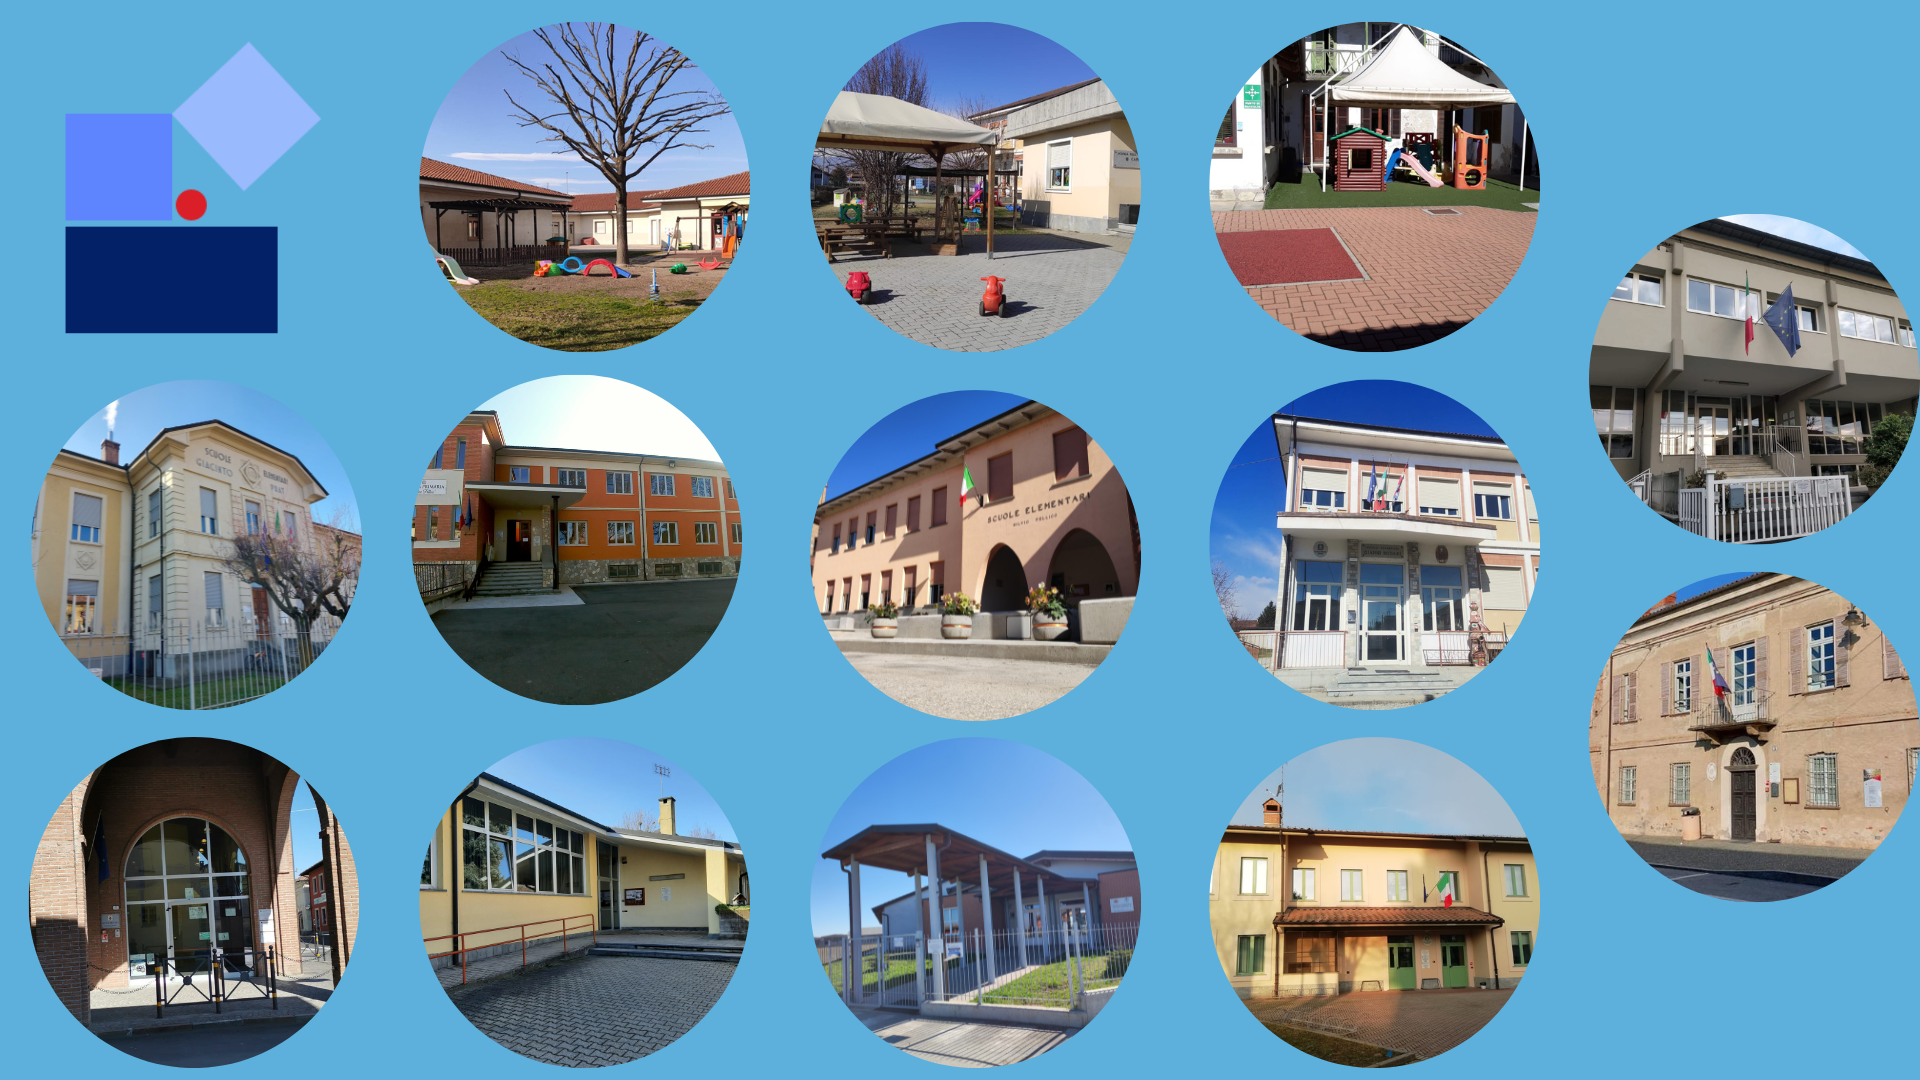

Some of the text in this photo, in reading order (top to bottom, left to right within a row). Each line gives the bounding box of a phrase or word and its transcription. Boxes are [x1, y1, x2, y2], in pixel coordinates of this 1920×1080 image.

[196, 457, 285, 494] GIACINTO PRAT
[204, 447, 288, 485] SCUOLE ELEMENTARI
[987, 491, 1091, 524] SCUOLE ELEMENTARI
[1013, 512, 1058, 527] SILVIO PELLICO
